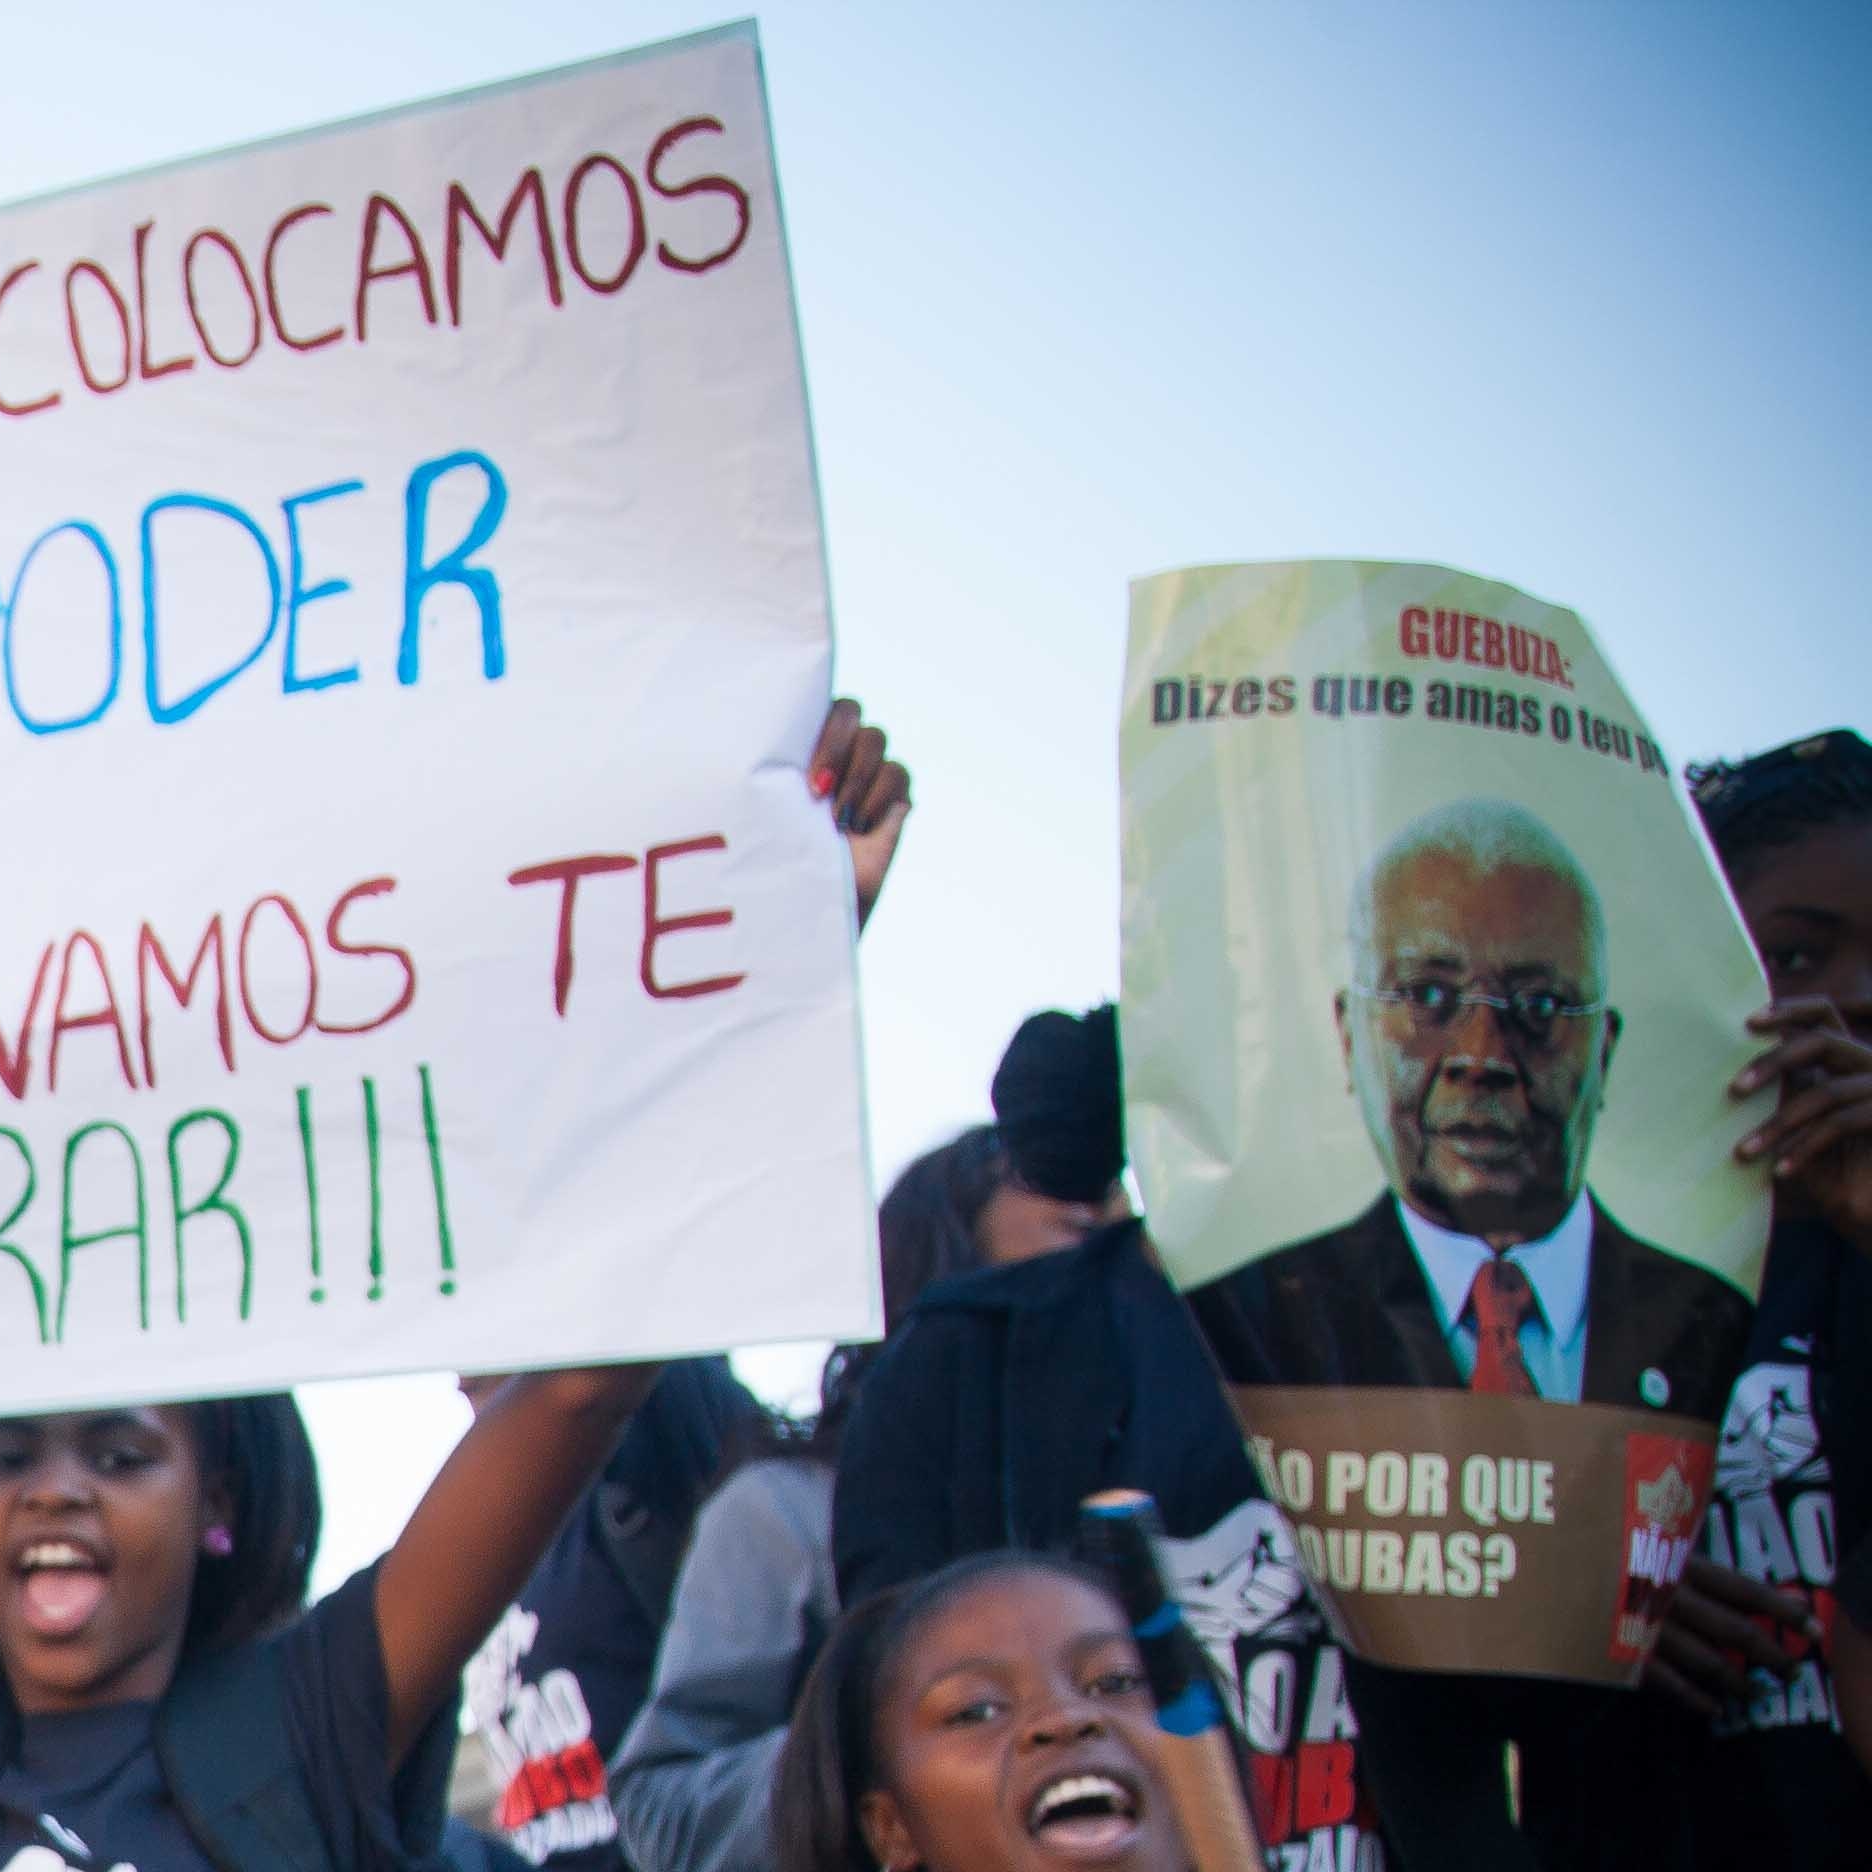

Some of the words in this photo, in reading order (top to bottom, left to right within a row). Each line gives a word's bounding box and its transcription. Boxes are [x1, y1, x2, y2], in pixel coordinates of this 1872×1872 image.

[1399, 604, 1576, 690] GUEBUZA:
[1150, 673, 1296, 727] Dizes
[1311, 675, 1413, 722] que
[1426, 679, 1542, 737] amas
[1549, 703, 1572, 743] o
[1577, 706, 1633, 763] teu
[510, 835, 745, 1016] TE
[1327, 1450, 1449, 1520] POR
[1463, 1454, 1555, 1526] QUE
[1296, 1523, 1518, 1599] OUBAS?
